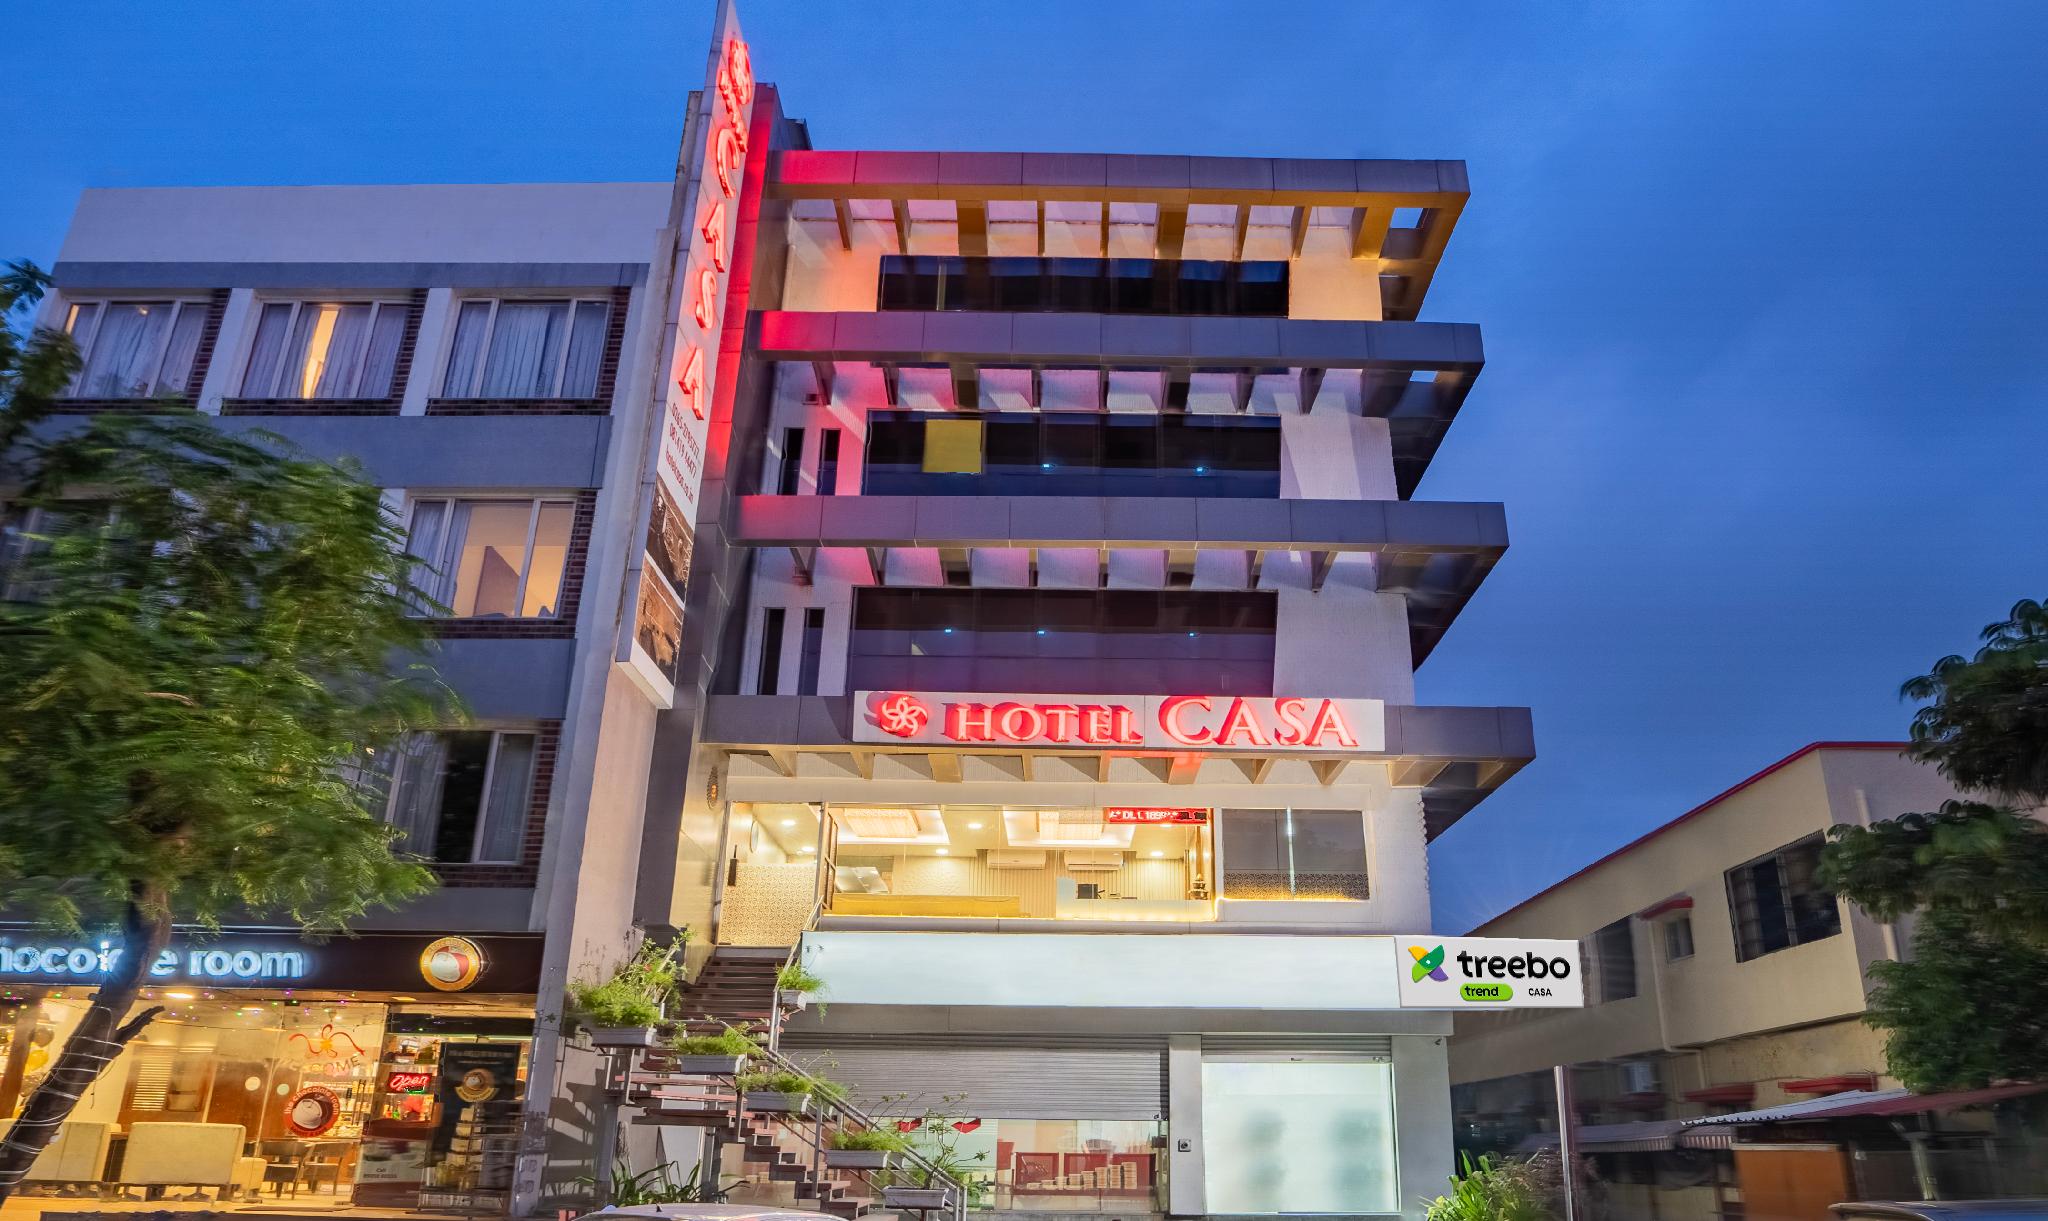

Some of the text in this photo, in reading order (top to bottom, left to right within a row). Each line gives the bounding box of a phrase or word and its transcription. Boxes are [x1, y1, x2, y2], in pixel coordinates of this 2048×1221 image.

[679, 128, 741, 420] CASA
[945, 695, 1361, 747] HOTEL CASA
[189, 950, 304, 978] room
[1457, 950, 1571, 980] treebo
[1465, 985, 1553, 997] trend CASA
[389, 1074, 429, 1092] Open
